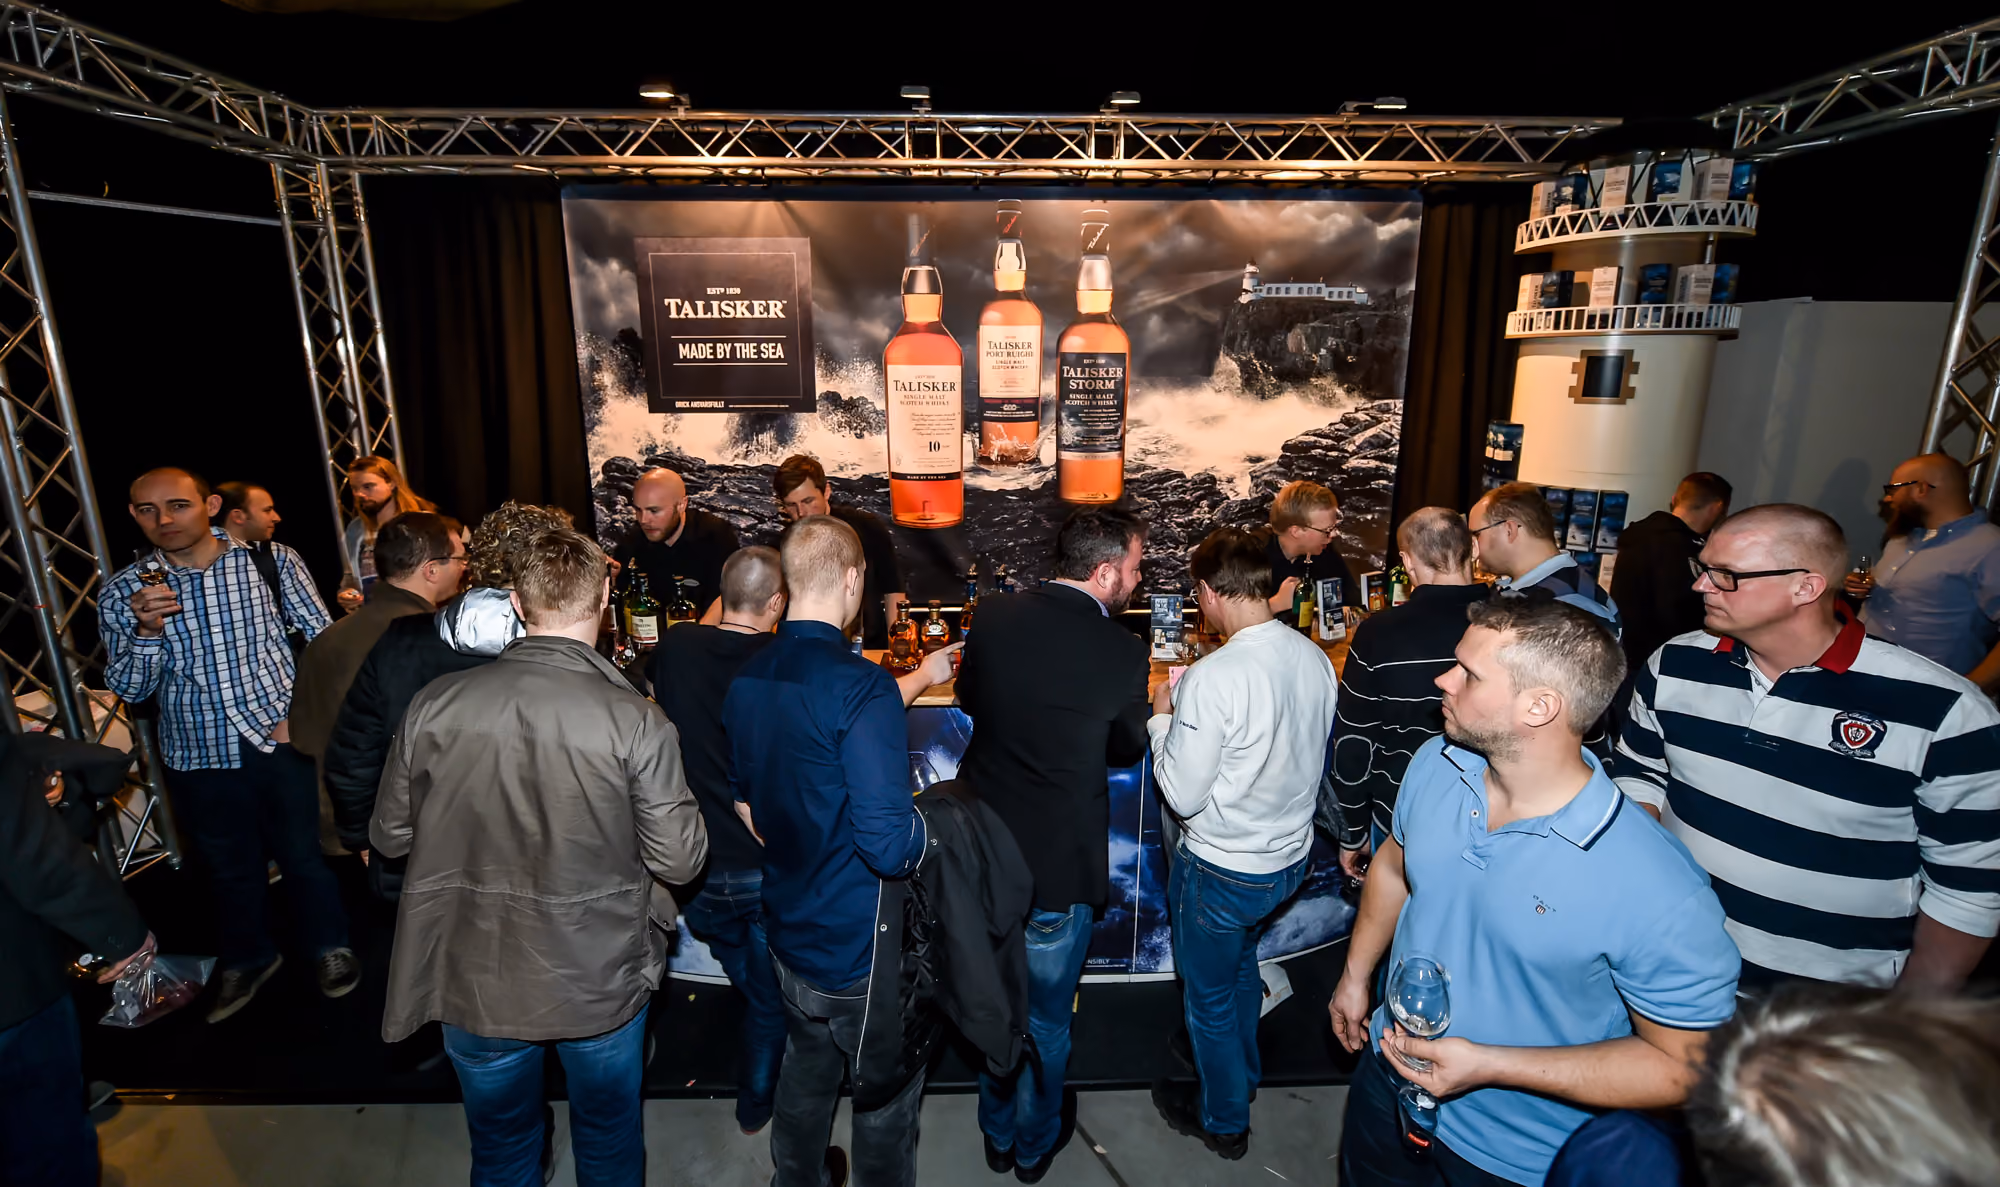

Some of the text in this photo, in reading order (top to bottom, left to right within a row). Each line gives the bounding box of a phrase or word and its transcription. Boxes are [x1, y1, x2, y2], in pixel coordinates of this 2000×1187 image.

[664, 298, 787, 319] TALISKER
[678, 342, 785, 359] MADE BY THE SEA
[988, 340, 1032, 350] TALISKER
[1062, 366, 1123, 378] TALISKER
[893, 380, 957, 392] TALISKER
[1069, 380, 1115, 390] STORM
[928, 441, 941, 453] 10
